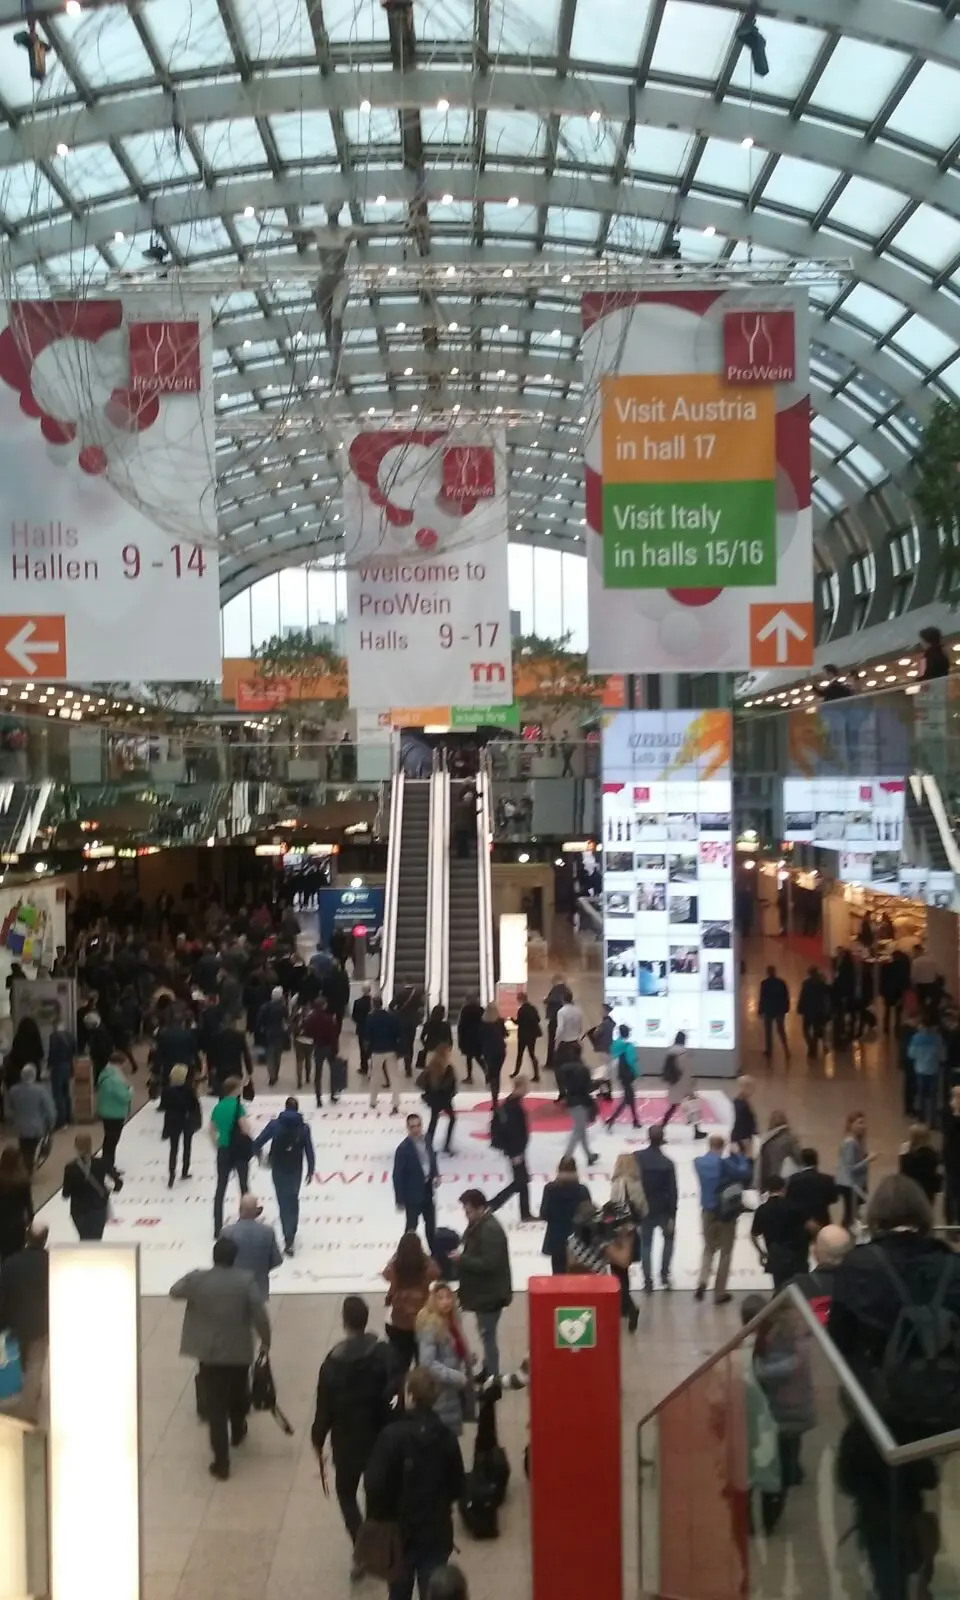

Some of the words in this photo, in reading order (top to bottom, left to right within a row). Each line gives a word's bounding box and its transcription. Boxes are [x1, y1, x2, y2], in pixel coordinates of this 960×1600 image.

[727, 365, 793, 381] ProWein
[614, 396, 666, 423] Visit
[671, 395, 757, 421] Austria
[616, 435, 636, 460] in
[643, 434, 685, 460] hall
[694, 433, 716, 459] 17
[613, 504, 665, 530] Visit
[671, 502, 721, 535] Italy
[11, 520, 79, 548] Halls
[12, 553, 99, 581] Hallen
[614, 542, 635, 567] in
[642, 540, 698, 567] halls
[705, 539, 764, 568] 15/16
[466, 561, 487, 581] to
[359, 592, 451, 616] ProWein
[360, 630, 408, 650] Halls
